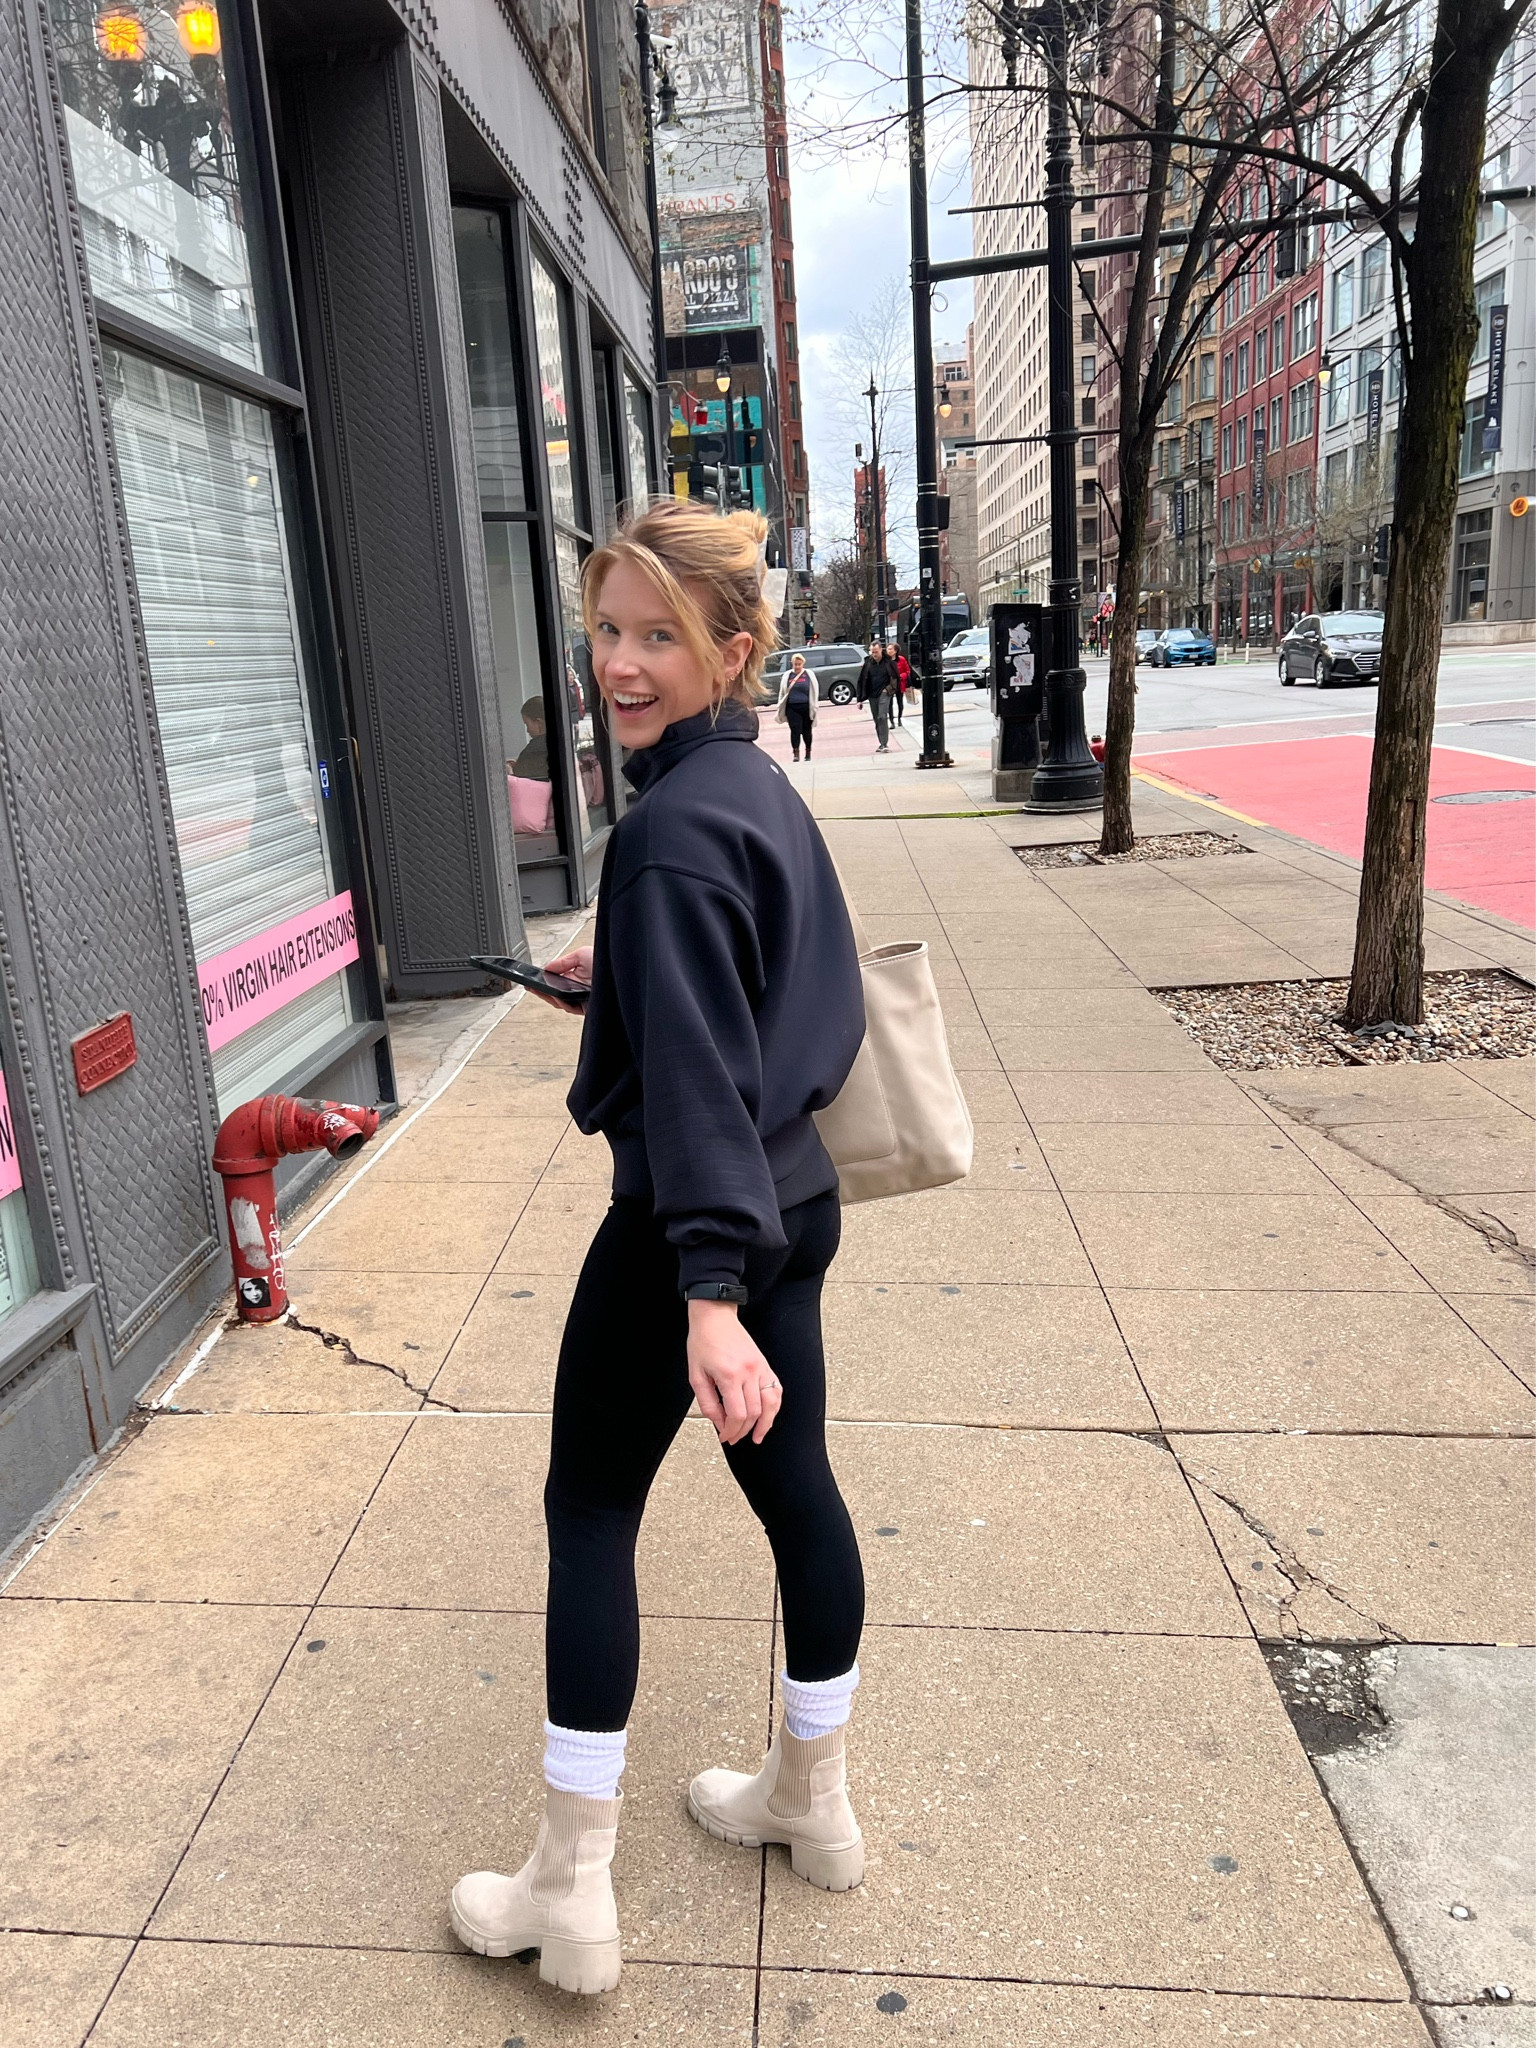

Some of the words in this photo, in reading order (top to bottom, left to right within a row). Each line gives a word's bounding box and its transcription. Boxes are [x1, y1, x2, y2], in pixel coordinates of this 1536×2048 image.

[1493, 331, 1503, 368] HOTEL
[1490, 370, 1501, 405] BLAKE
[223, 958, 269, 1012] VIRGIN
[268, 941, 297, 987] HAIR
[297, 909, 356, 970] EXTENSIONS
